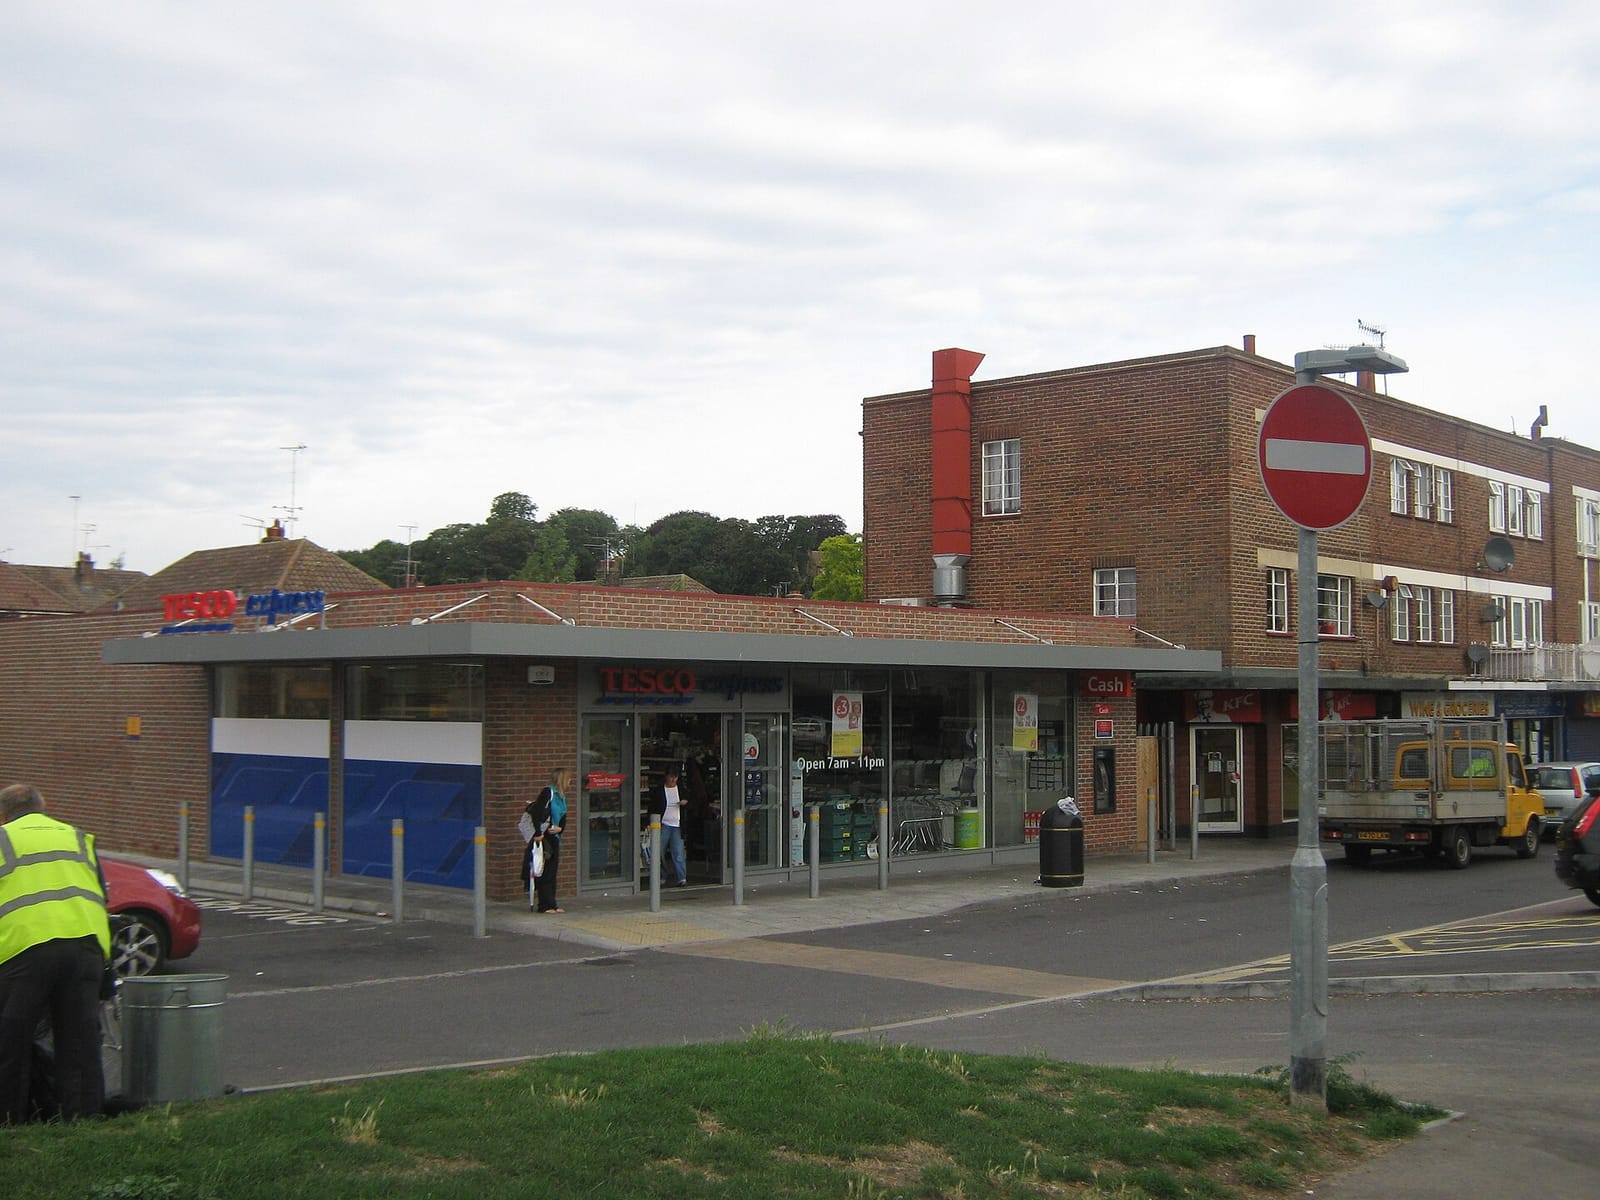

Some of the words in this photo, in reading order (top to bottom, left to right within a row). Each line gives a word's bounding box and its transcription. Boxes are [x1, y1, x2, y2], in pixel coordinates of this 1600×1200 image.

[160, 590, 237, 622] TESCO
[599, 668, 697, 694] TESCO
[1087, 676, 1124, 692] Cash
[1223, 693, 1255, 711] KFC
[1409, 702, 1435, 717] WINE
[1444, 702, 1489, 717] GROCERIES
[797, 757, 825, 773] Open
[827, 757, 849, 769] 7am
[858, 756, 885, 771] 11pm
